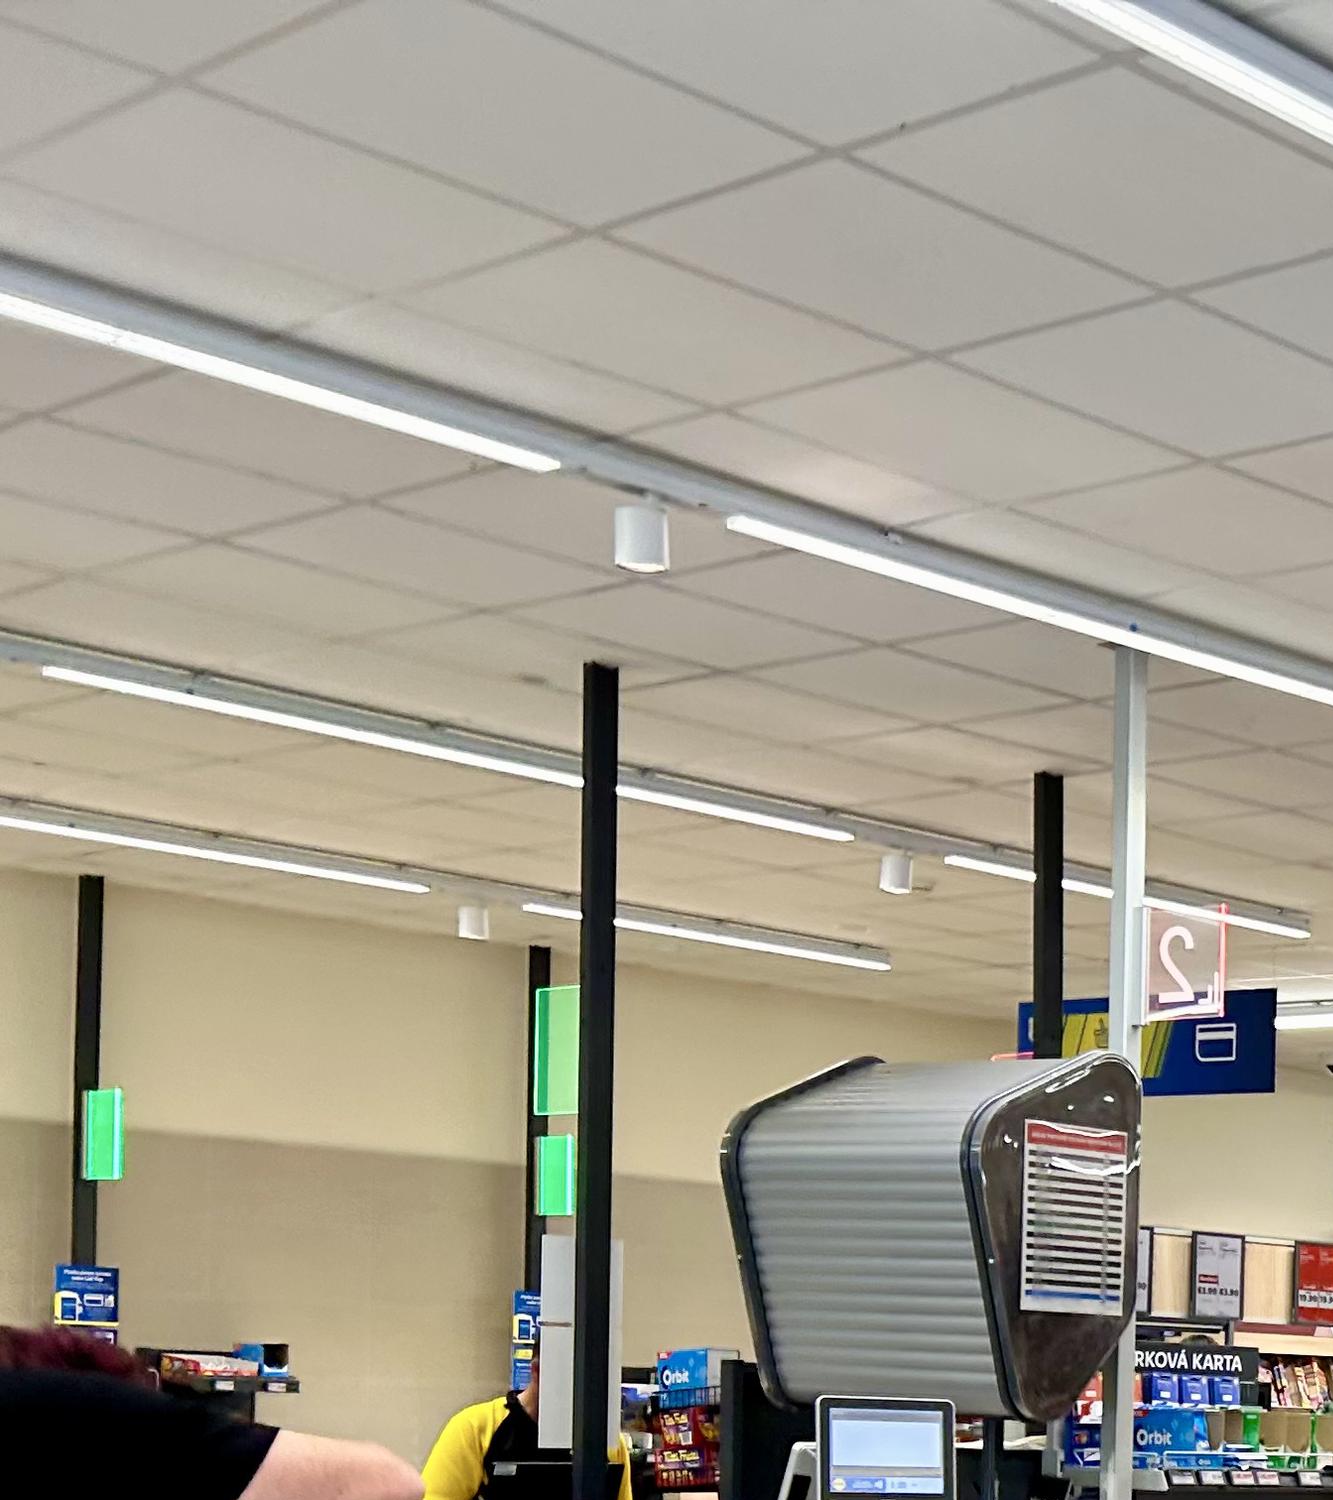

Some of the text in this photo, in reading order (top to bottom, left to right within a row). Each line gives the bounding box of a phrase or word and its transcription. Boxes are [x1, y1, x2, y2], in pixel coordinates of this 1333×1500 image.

[1135, 1349, 1243, 1372] RKOVÁ KARTA
[662, 1368, 689, 1386] Orbit
[1136, 1428, 1172, 1446] Orbit
